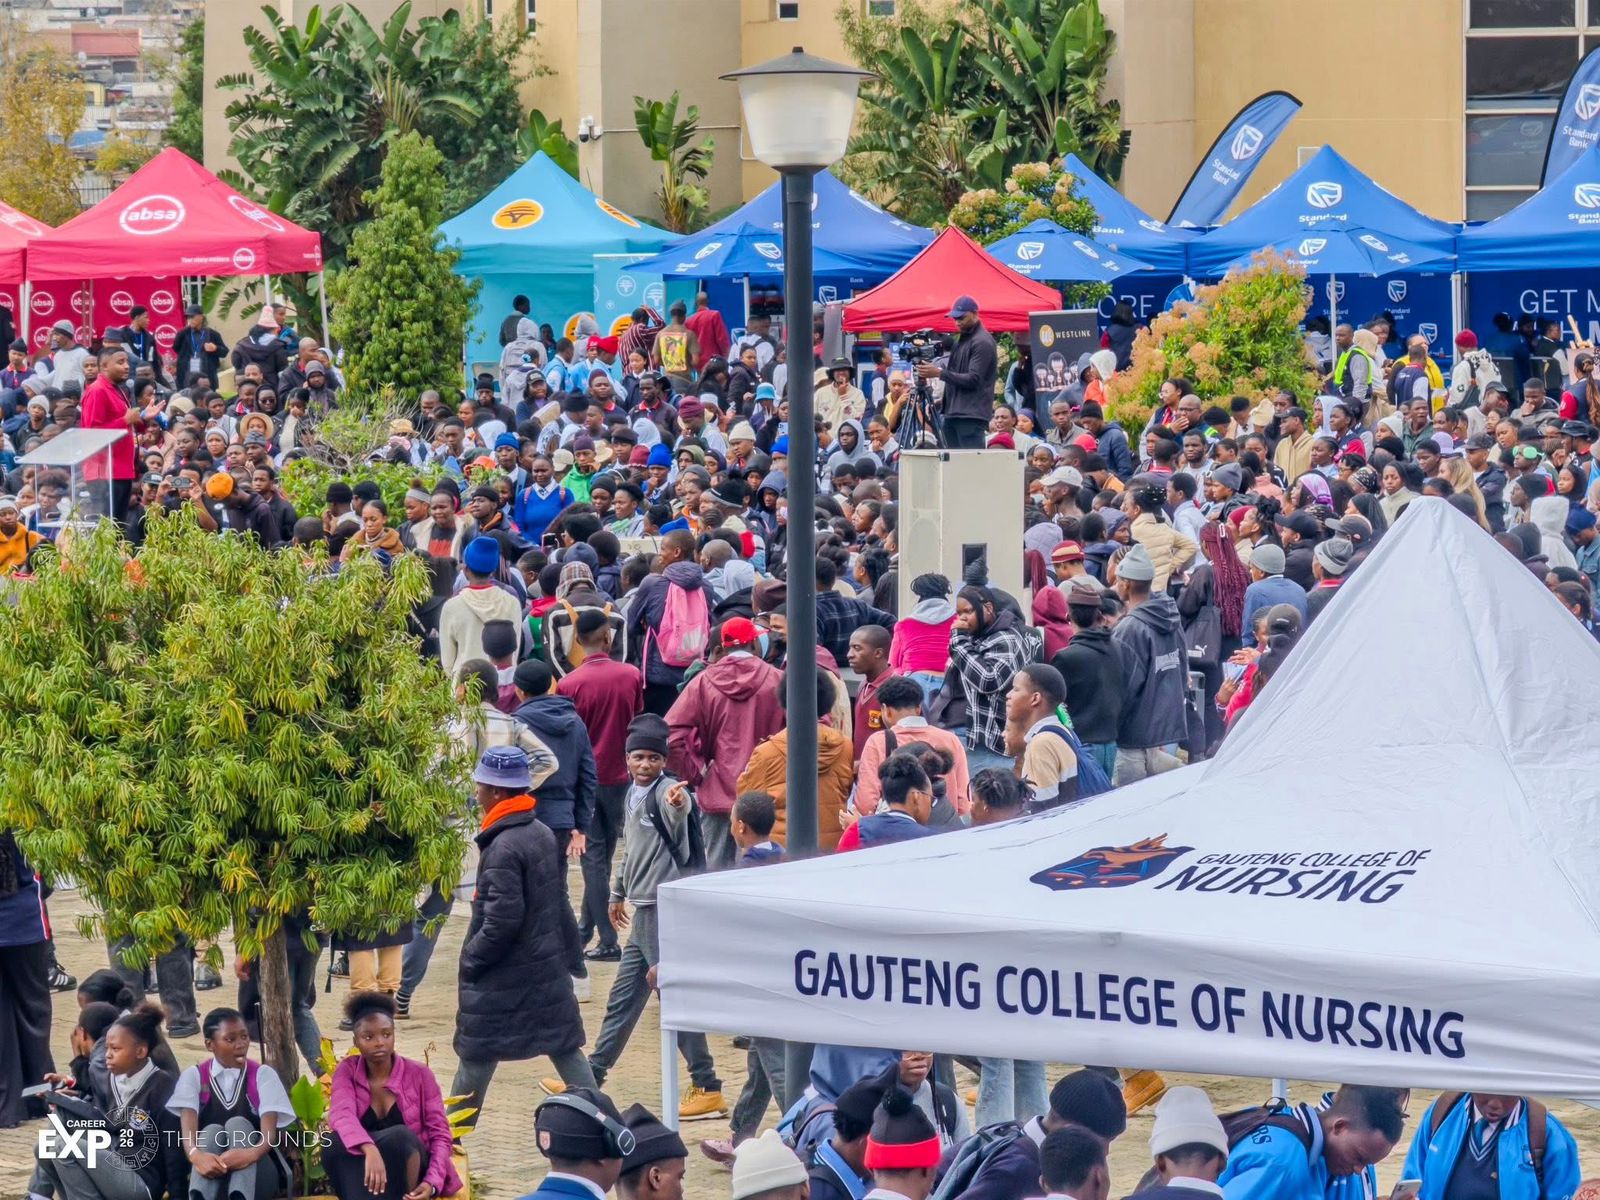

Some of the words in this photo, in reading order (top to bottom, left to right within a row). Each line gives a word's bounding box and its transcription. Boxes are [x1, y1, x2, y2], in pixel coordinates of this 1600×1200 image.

[1563, 126, 1598, 141] Standard
[1569, 136, 1589, 149] Bank
[128, 207, 177, 221] absa
[1298, 213, 1348, 223] Standd
[1568, 212, 1600, 220] Stand
[1093, 225, 1125, 235] Bank
[33, 298, 52, 306] absa
[113, 298, 132, 306] absa
[153, 297, 172, 305] absa
[1073, 294, 1155, 319] ORE
[1520, 289, 1578, 314] GET
[1056, 330, 1091, 339] WESTLINK
[1196, 852, 1302, 866] GAUTENG
[1300, 851, 1400, 868] COLLEGE
[1395, 848, 1432, 866] OF
[1153, 865, 1417, 904] NURSING
[794, 949, 981, 1010] GAUTENG
[996, 965, 1178, 1028] COLLEGE
[1191, 983, 1246, 1033] OF
[1261, 991, 1466, 1058] NURSING
